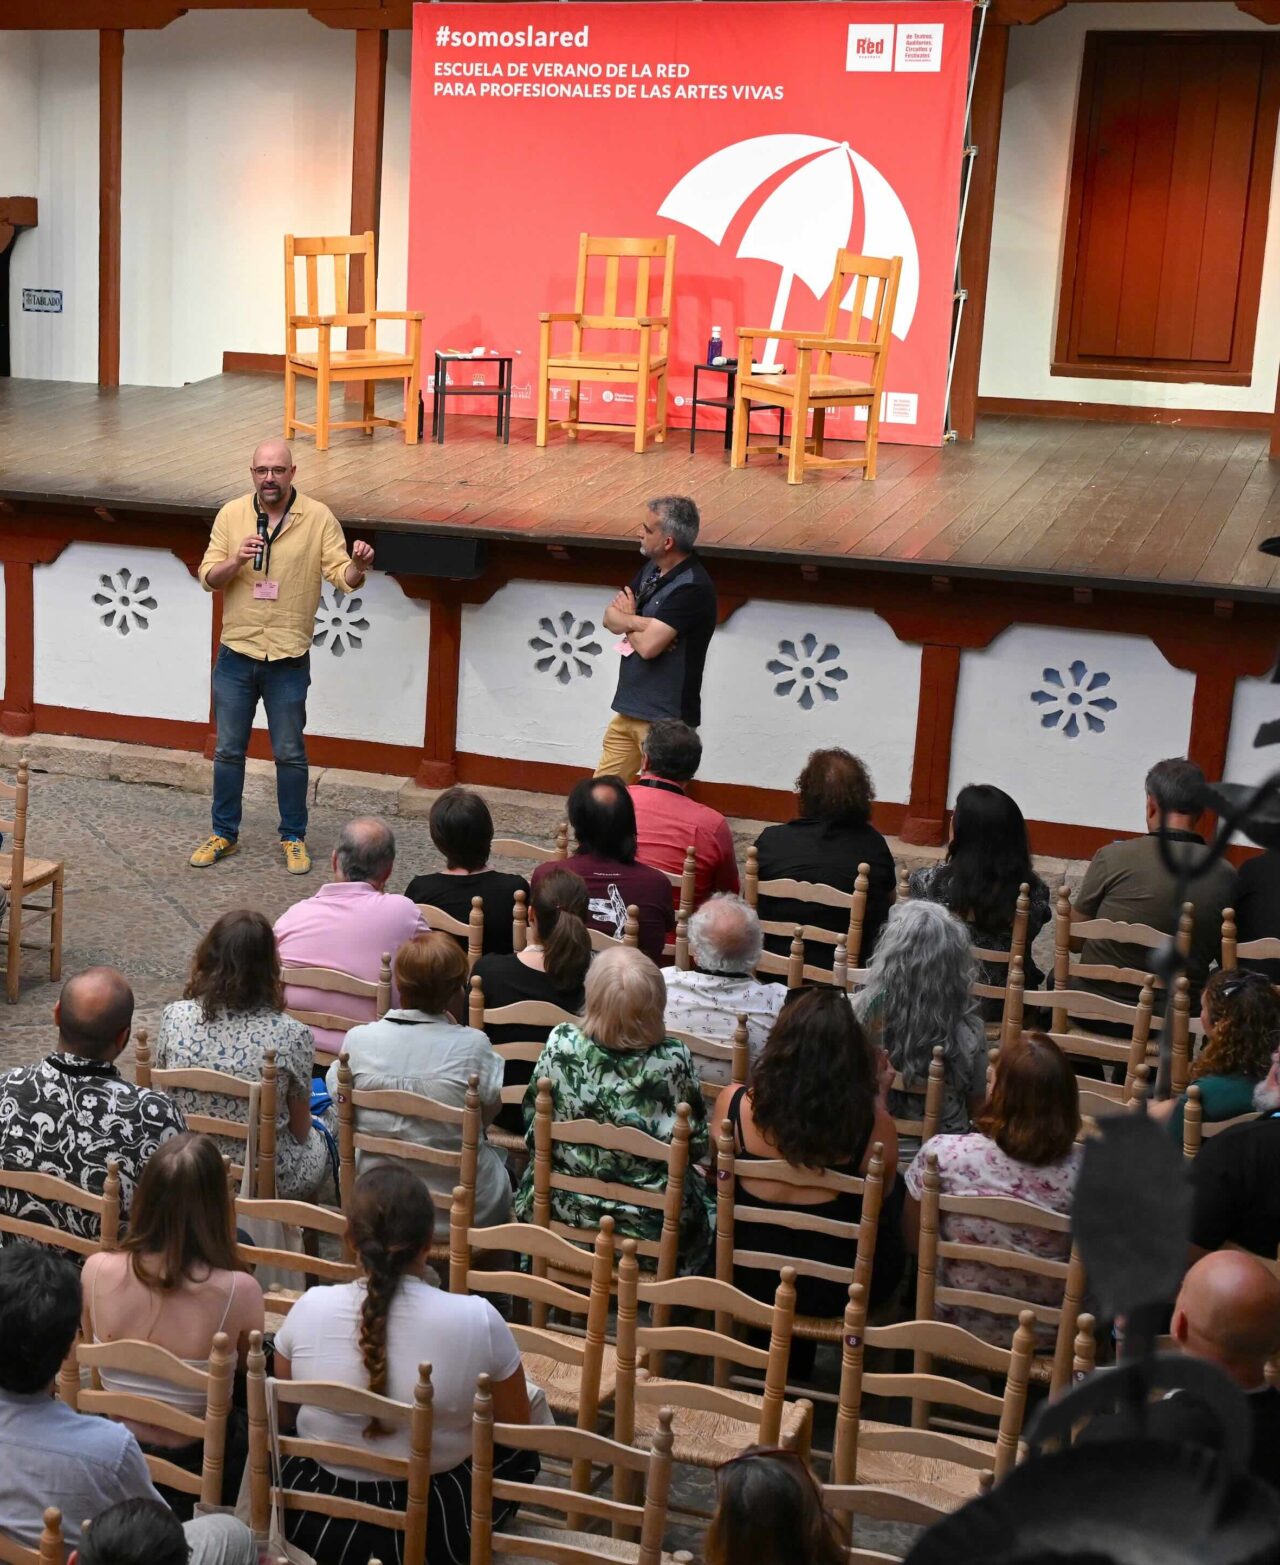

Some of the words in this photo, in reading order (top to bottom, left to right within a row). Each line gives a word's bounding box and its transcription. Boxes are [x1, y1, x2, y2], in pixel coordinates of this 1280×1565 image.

[435, 25, 589, 48] #somoslared
[856, 37, 884, 54] Red
[434, 62, 504, 77] ESCUELA
[507, 63, 529, 77] DE
[532, 63, 602, 78] VERANO
[606, 63, 628, 78] DE
[631, 63, 653, 78] LA
[656, 63, 690, 78] RED
[433, 82, 477, 97] PARA
[480, 82, 612, 98] PROFESIONALES
[615, 84, 637, 98] DE
[640, 84, 672, 99] LAS
[674, 84, 728, 99] ARTES
[731, 85, 784, 100] VIVAS
[32, 294, 61, 306] TABLADO
